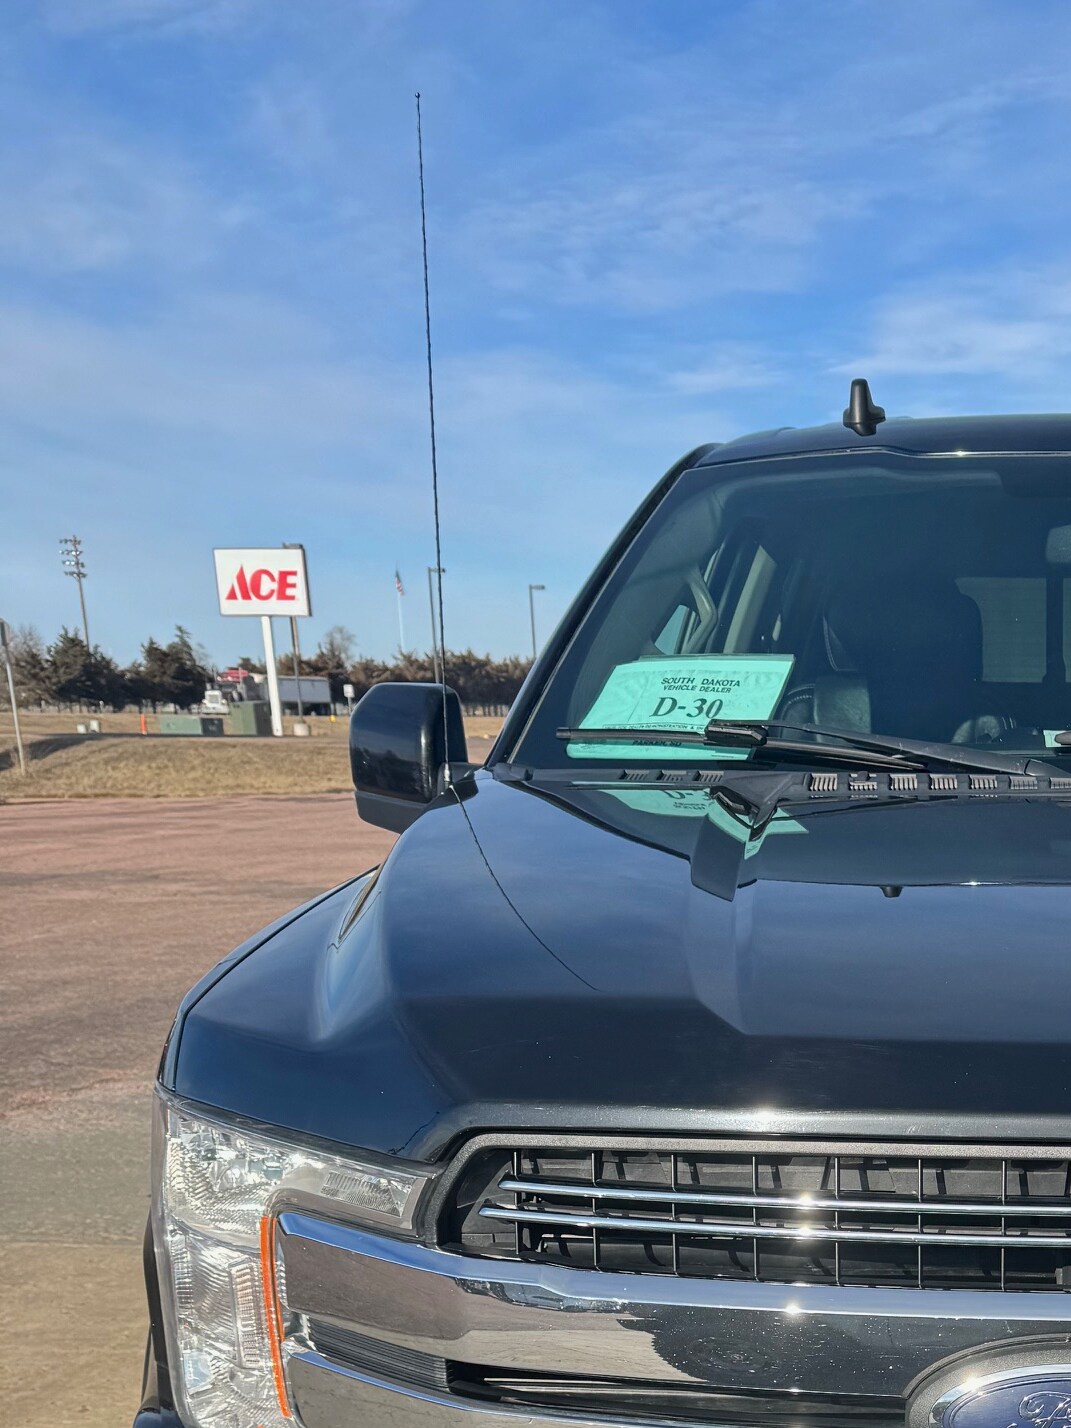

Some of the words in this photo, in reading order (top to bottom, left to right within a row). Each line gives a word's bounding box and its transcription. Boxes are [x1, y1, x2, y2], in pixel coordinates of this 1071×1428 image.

[225, 564, 297, 601] ACE
[701, 678, 741, 687] DAKOTA
[650, 697, 723, 719] D-30
